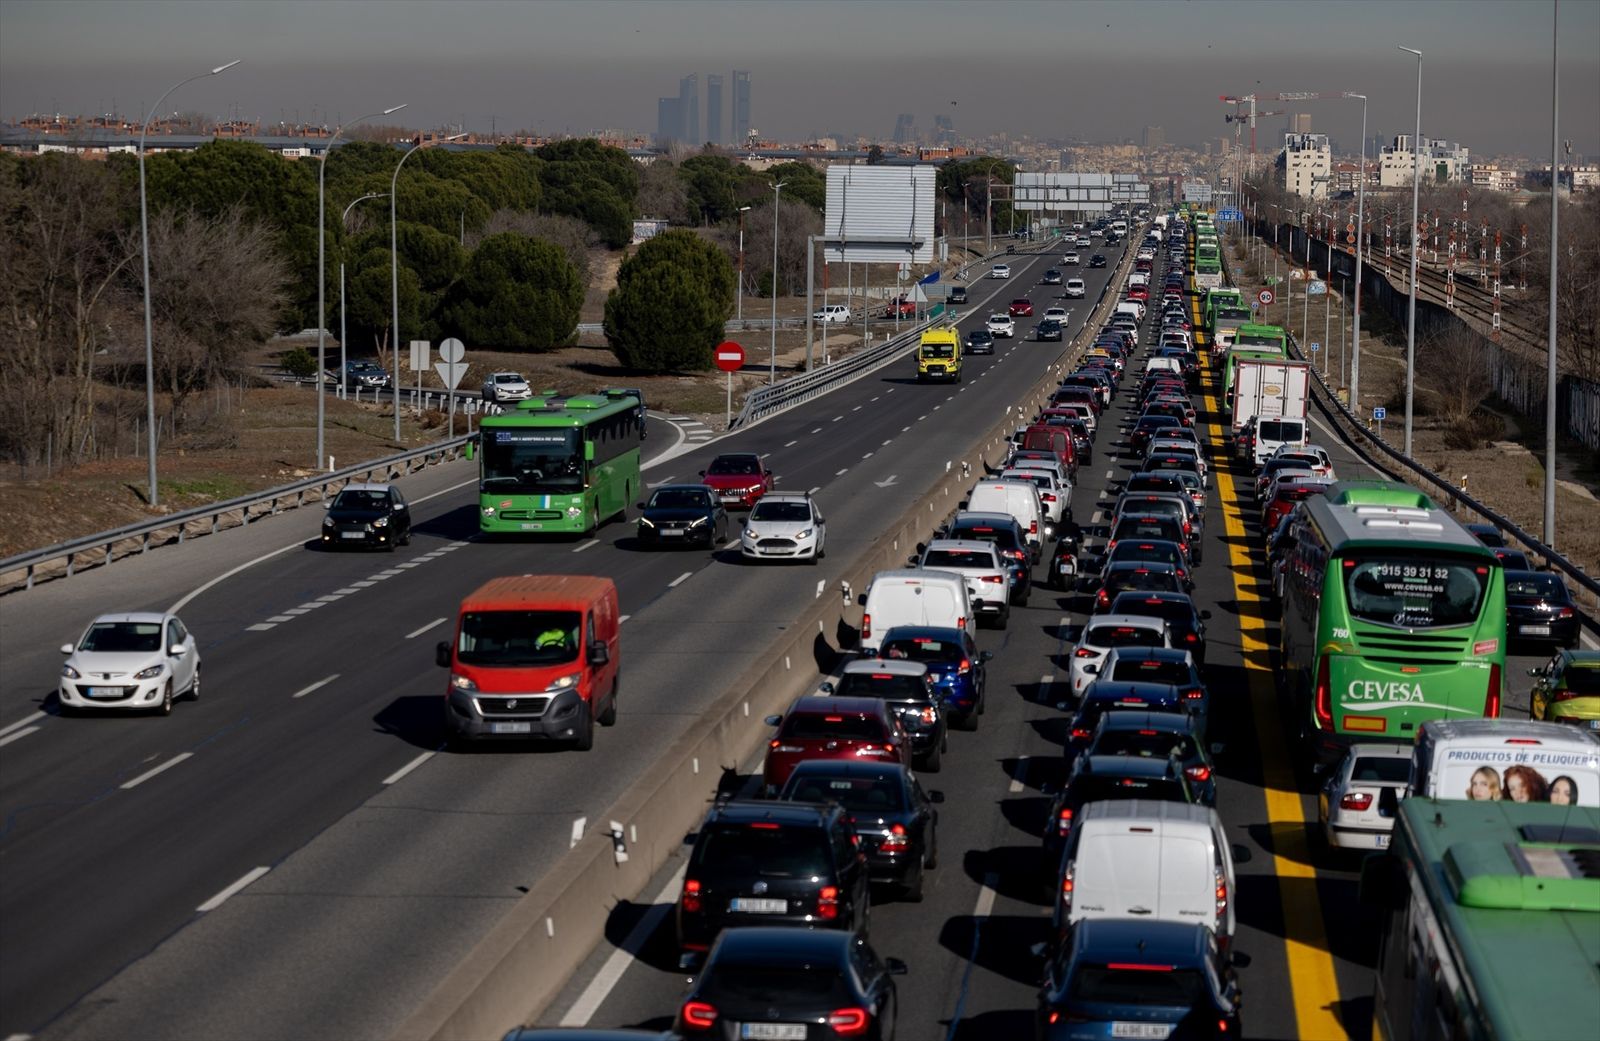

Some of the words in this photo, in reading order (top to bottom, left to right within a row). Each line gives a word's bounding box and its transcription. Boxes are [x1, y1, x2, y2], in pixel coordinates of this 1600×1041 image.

[1381, 565, 1401, 576] 915
[1403, 567, 1417, 577] 39
[1419, 567, 1432, 578] 31
[1434, 568, 1449, 579] 32
[1384, 582, 1444, 593] www.cevesa.es
[1332, 628, 1350, 638] 760
[1348, 680, 1424, 702] CEVESA
[1448, 751, 1512, 761] PRODUCTOS
[1515, 752, 1530, 763] DE
